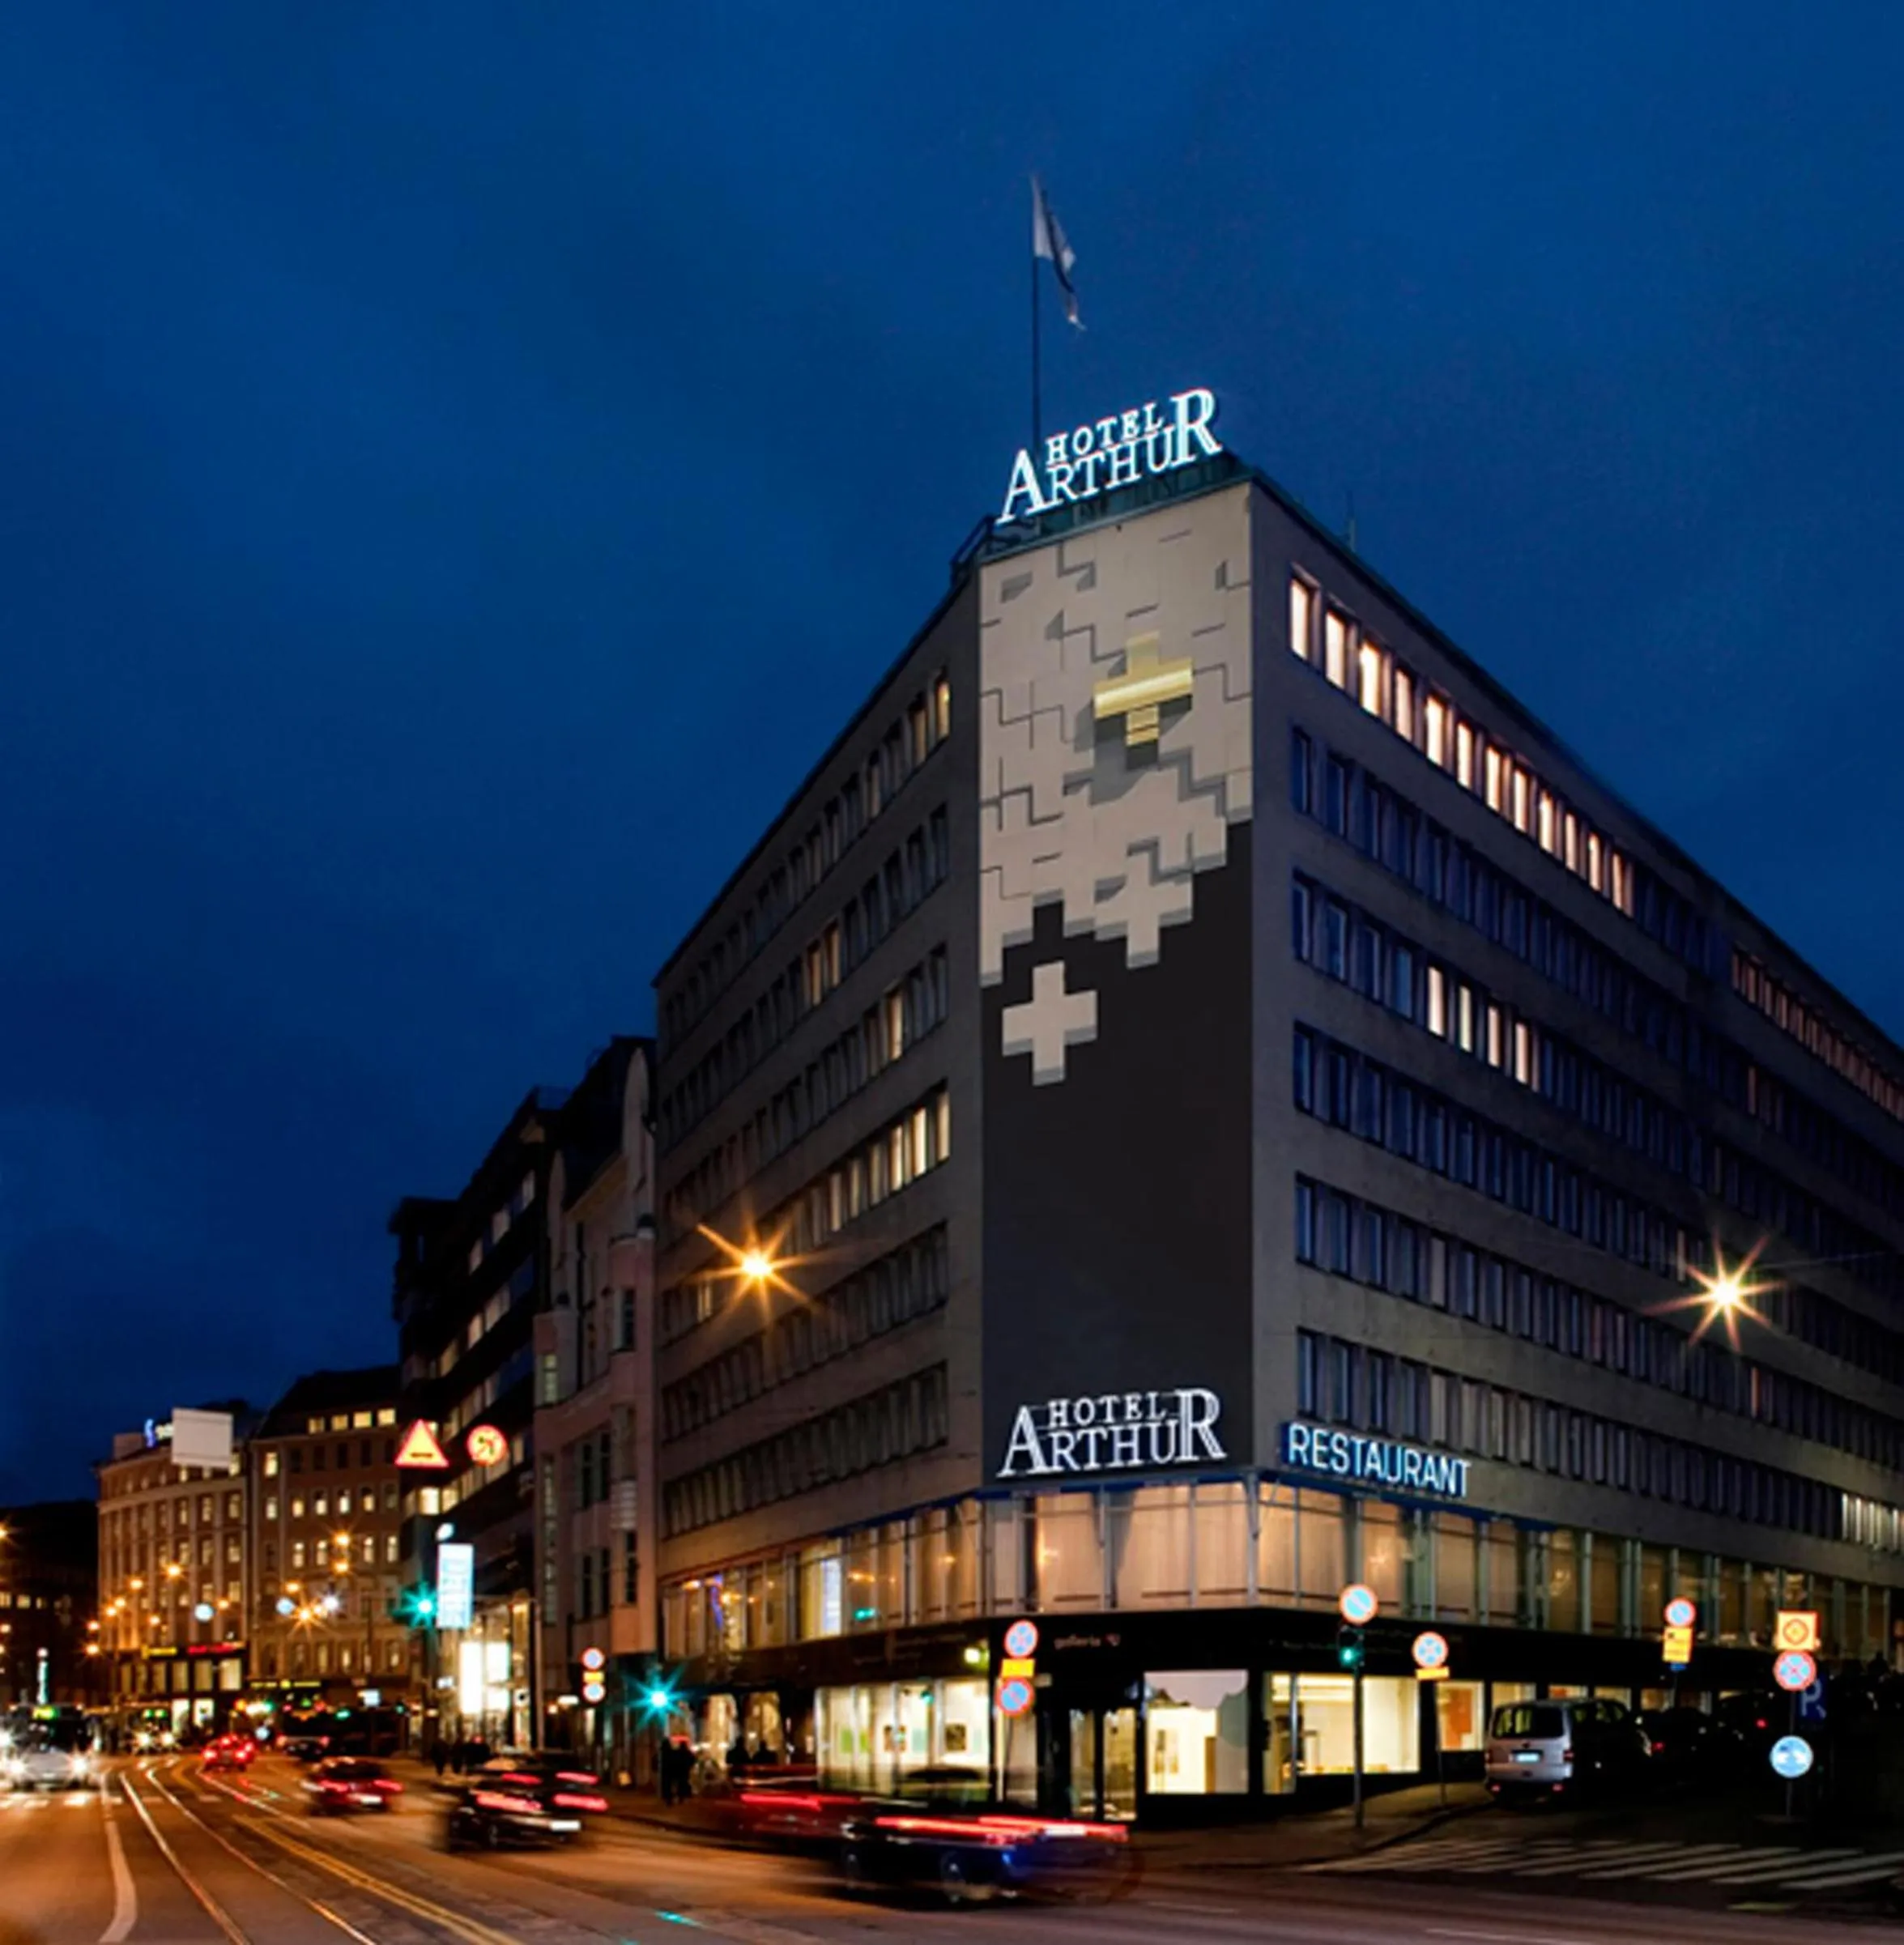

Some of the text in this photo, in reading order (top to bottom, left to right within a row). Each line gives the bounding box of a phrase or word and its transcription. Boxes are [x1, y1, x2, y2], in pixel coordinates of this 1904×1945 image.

[995, 387, 1223, 526] ARTHUR
[1045, 402, 1164, 466] HOTEL
[995, 1387, 1228, 1478] ARTHUR
[1047, 1391, 1167, 1428] HOTEL
[1288, 1424, 1472, 1497] RESTAURANT
